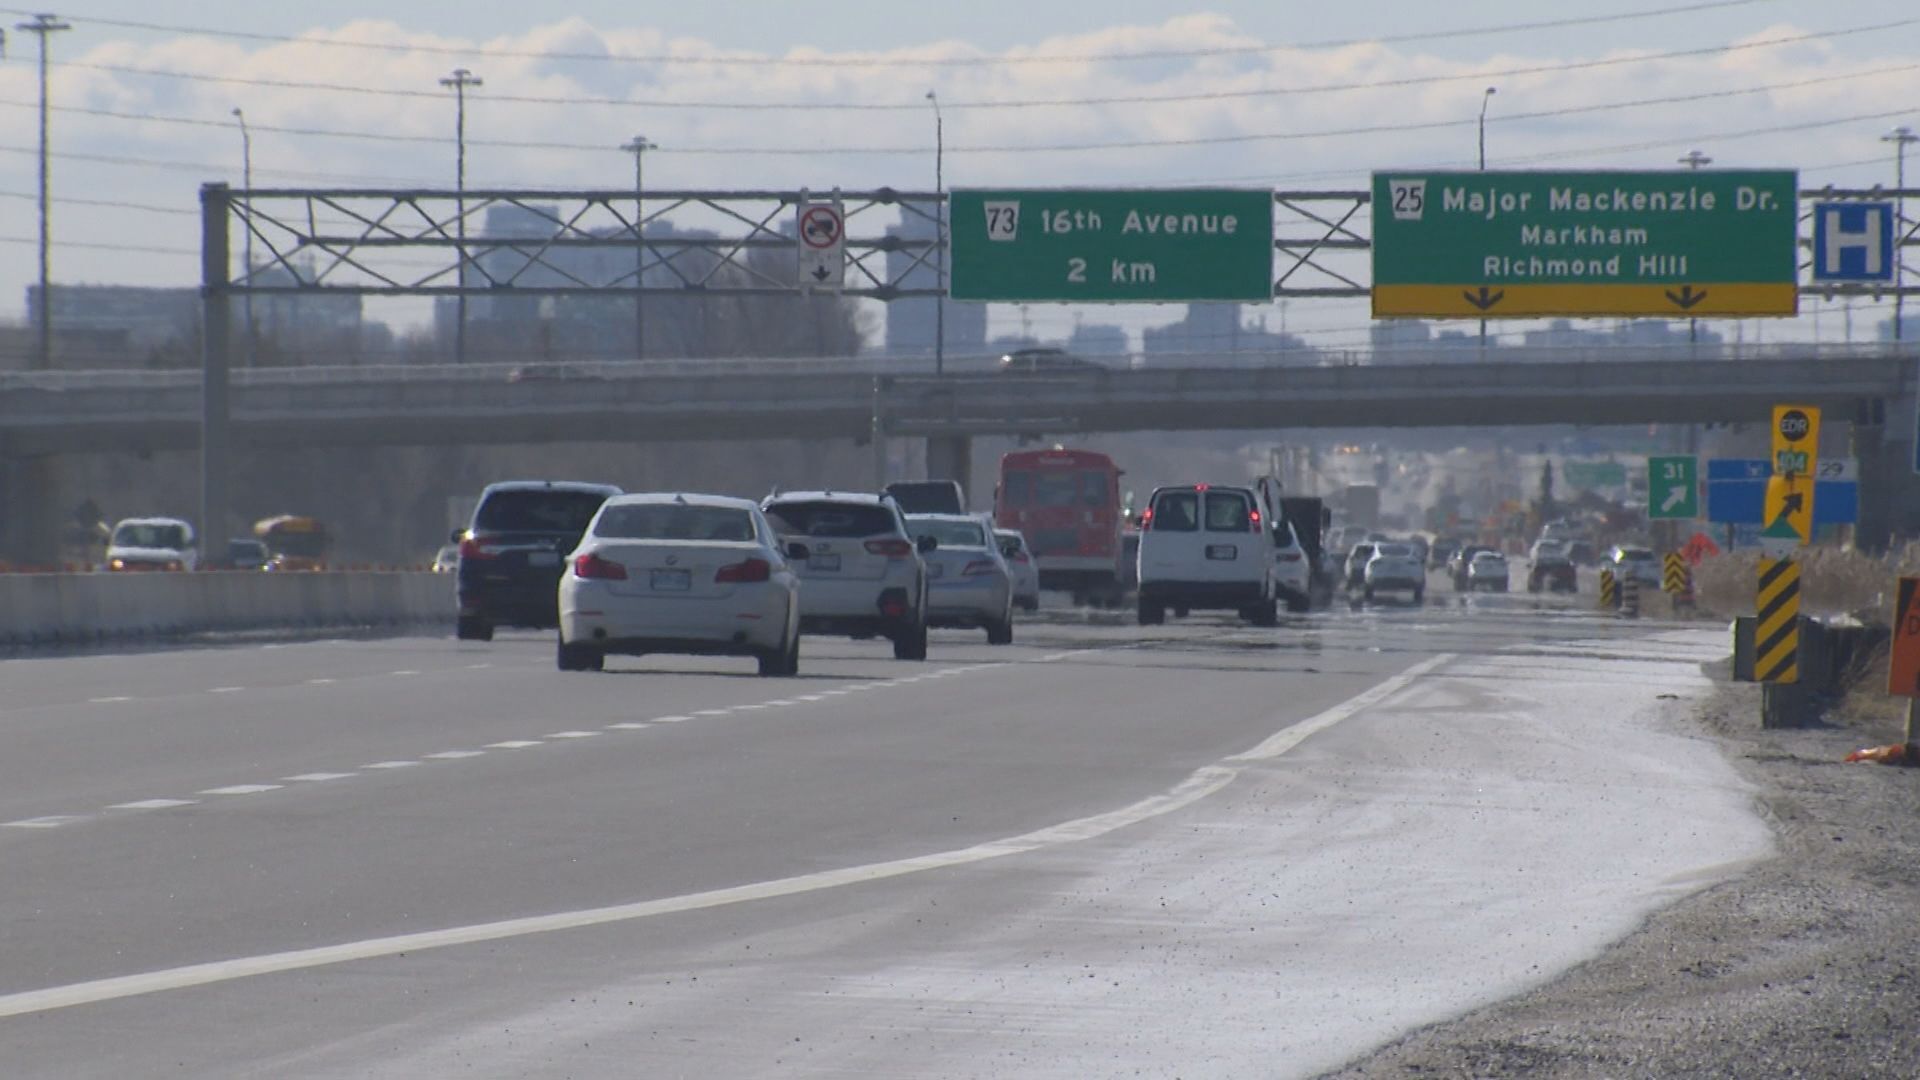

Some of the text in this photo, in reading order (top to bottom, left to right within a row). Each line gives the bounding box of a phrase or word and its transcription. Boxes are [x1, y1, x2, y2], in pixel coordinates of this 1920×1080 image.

[1395, 187, 1422, 211] 25
[1443, 187, 1779, 219] Major Mackenzie Dr.
[988, 207, 1015, 233] 73
[1042, 209, 1238, 233] 16th Avenue
[1522, 225, 1647, 244] Markham
[1825, 210, 1881, 273] H
[1067, 258, 1156, 281] 2 km
[1484, 256, 1687, 276] Richmond Hill
[1782, 419, 1807, 432] EDR
[1664, 463, 1683, 479] 31
